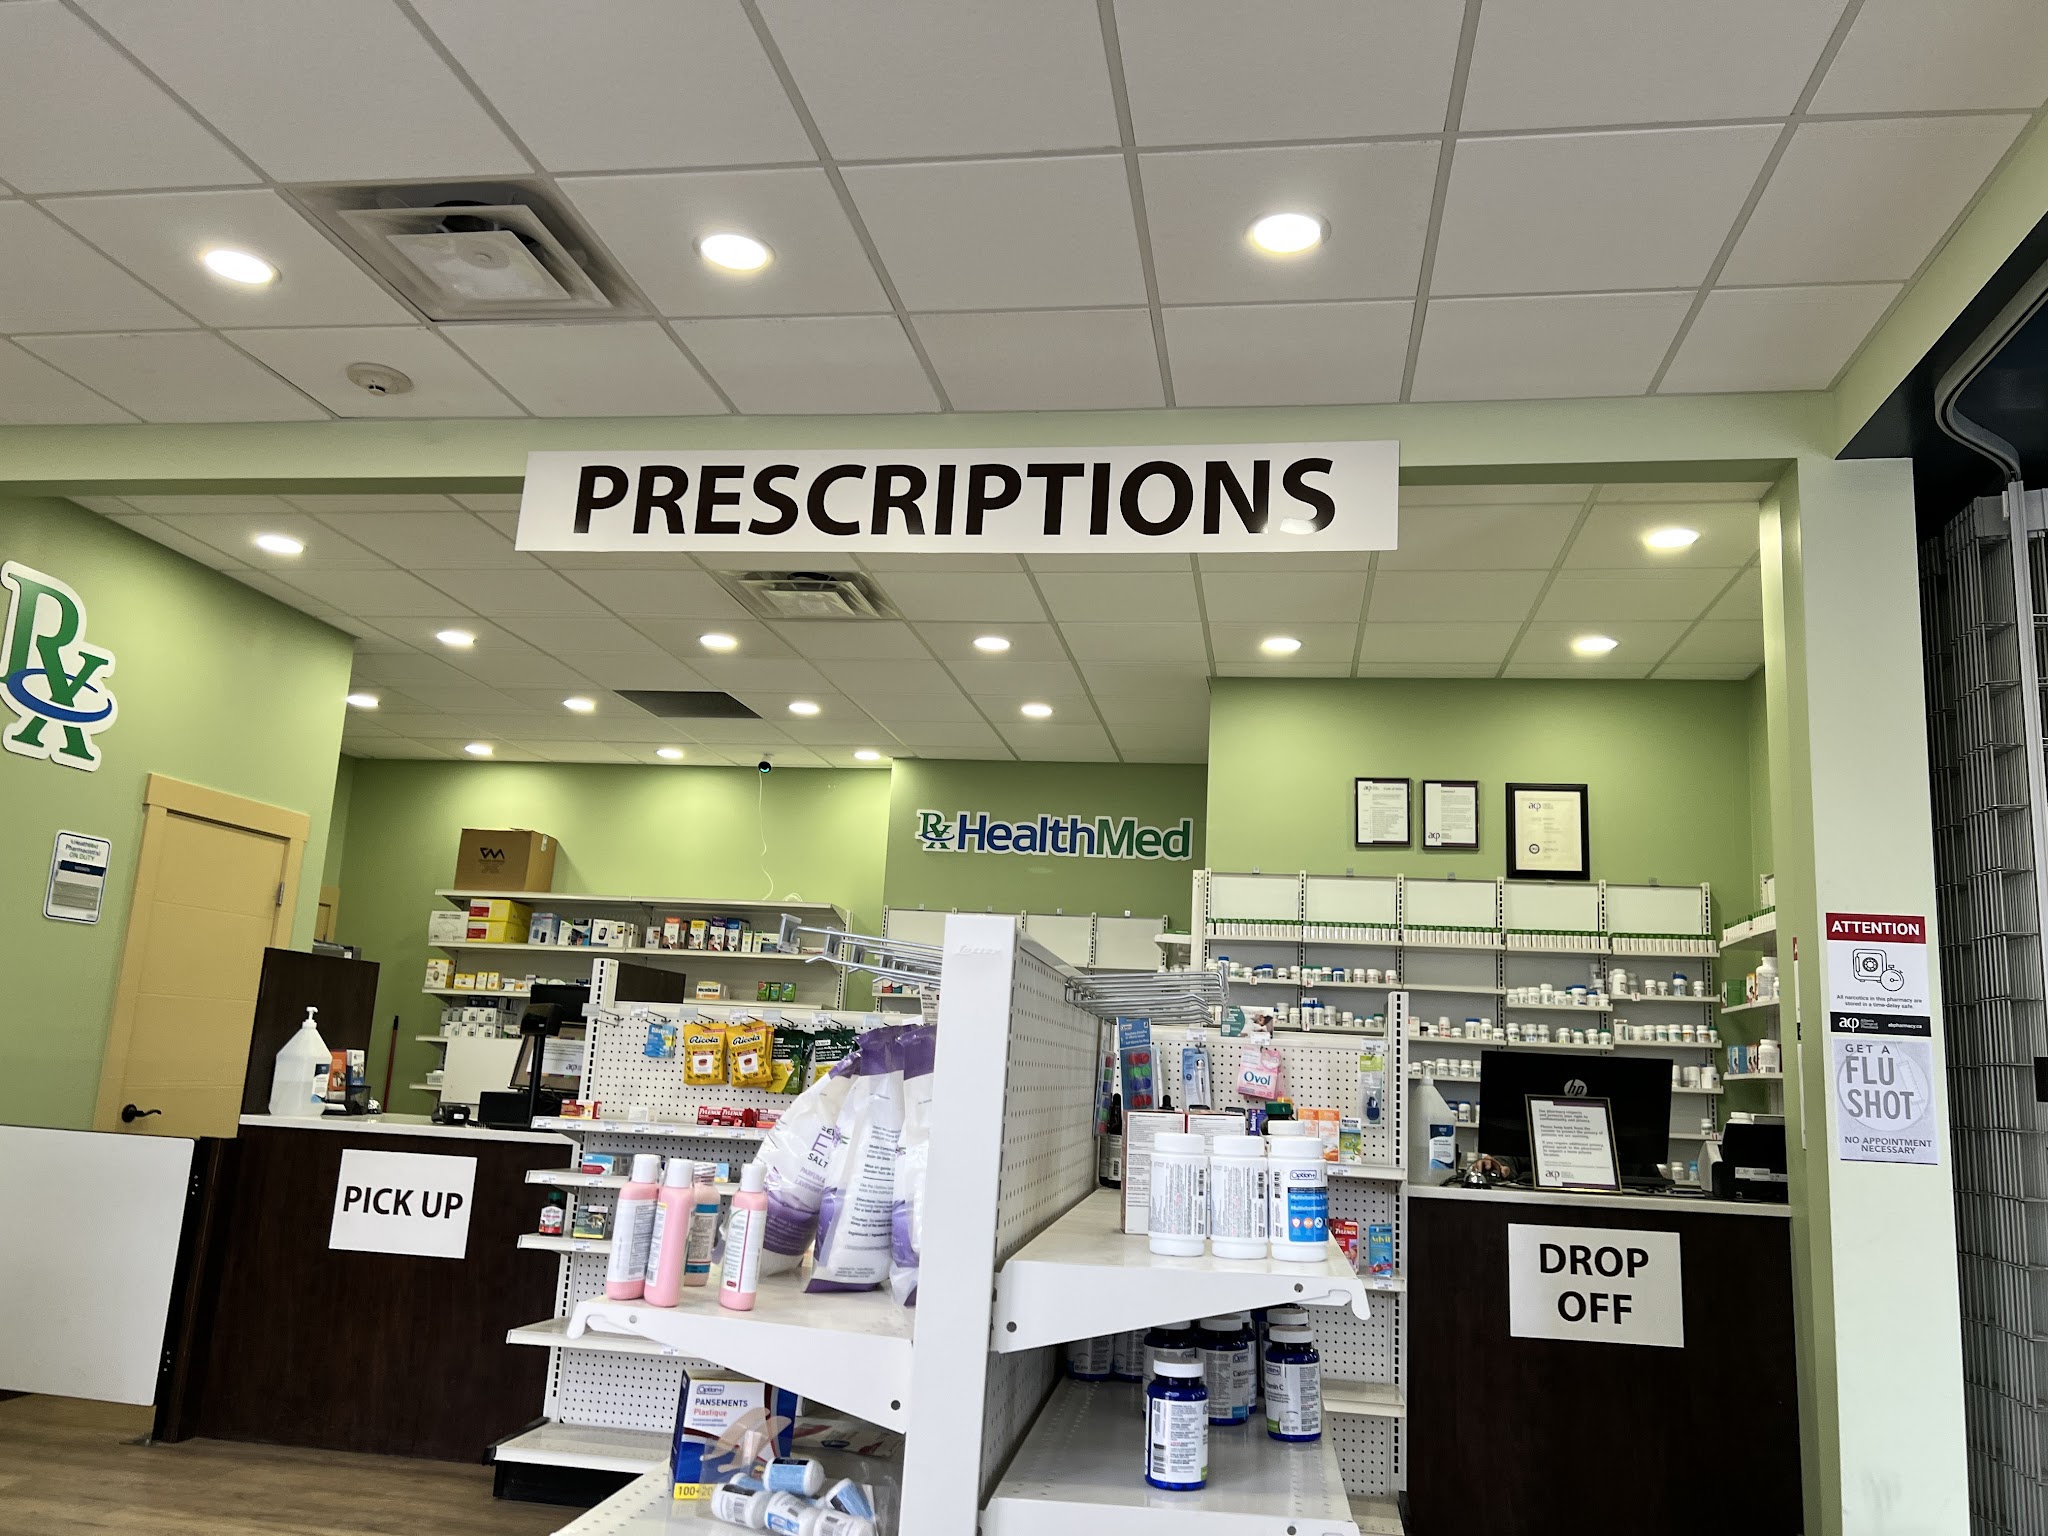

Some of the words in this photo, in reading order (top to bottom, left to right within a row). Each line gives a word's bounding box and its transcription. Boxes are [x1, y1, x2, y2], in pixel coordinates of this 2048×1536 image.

[575, 457, 1335, 537] PRESCRIPTIONS
[957, 814, 1190, 857] HealthMed
[1831, 920, 1920, 936] ATTENTION
[690, 1036, 718, 1044] Ricola
[732, 1034, 760, 1045] Ricola
[1845, 1044, 1873, 1053] GET
[1881, 1046, 1890, 1054] A
[1244, 1071, 1270, 1085] Ovol
[1846, 1056, 1894, 1086] FLU
[1567, 1080, 1585, 1096] hp
[1848, 1088, 1914, 1120] SHOT
[1844, 1136, 1859, 1144] NO
[1862, 1138, 1932, 1147] APPOINTMENT
[1861, 1145, 1916, 1154] NECESSARY
[808, 1153, 828, 1168] SALT
[343, 1186, 414, 1216] PICK
[422, 1191, 463, 1218] UP
[1540, 1244, 1649, 1278] DROP
[1558, 1291, 1632, 1324] OFF
[695, 1398, 748, 1407] PANSEMENTS
[694, 1408, 727, 1416] Plastique
